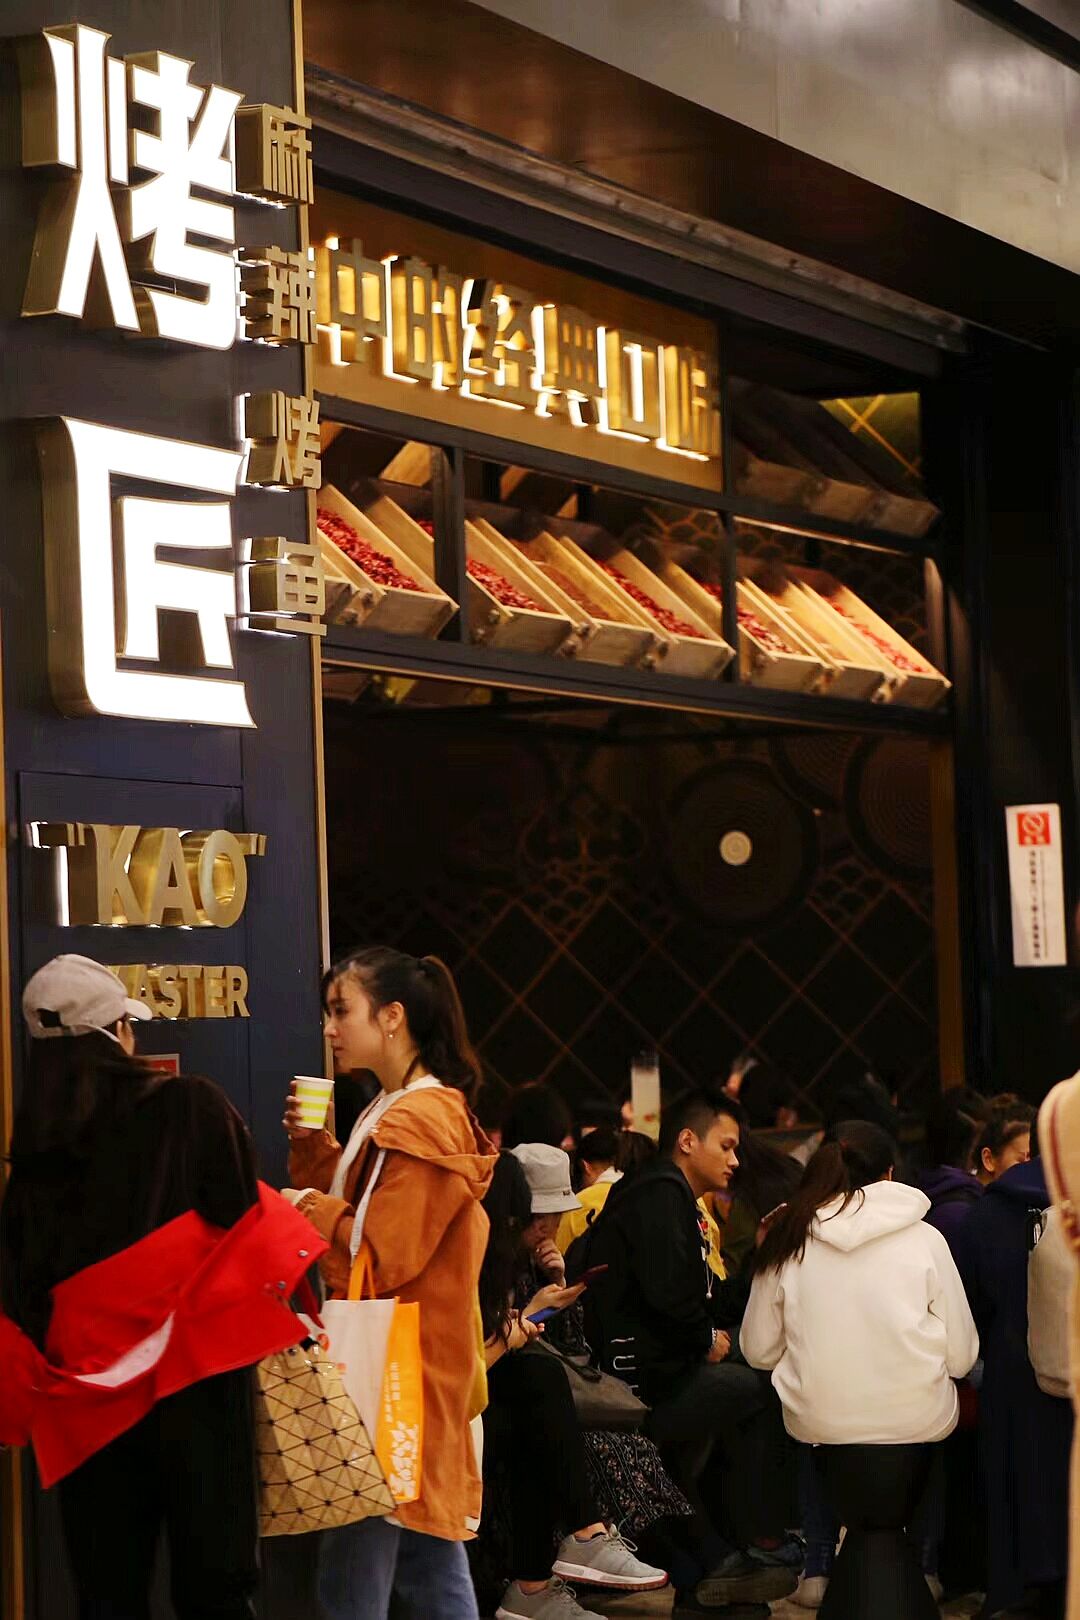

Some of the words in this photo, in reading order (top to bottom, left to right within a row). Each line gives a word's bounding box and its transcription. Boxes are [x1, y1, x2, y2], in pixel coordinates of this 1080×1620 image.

[43, 24, 256, 728] 烤匠
[262, 103, 327, 637] 麻辣烤鱼
